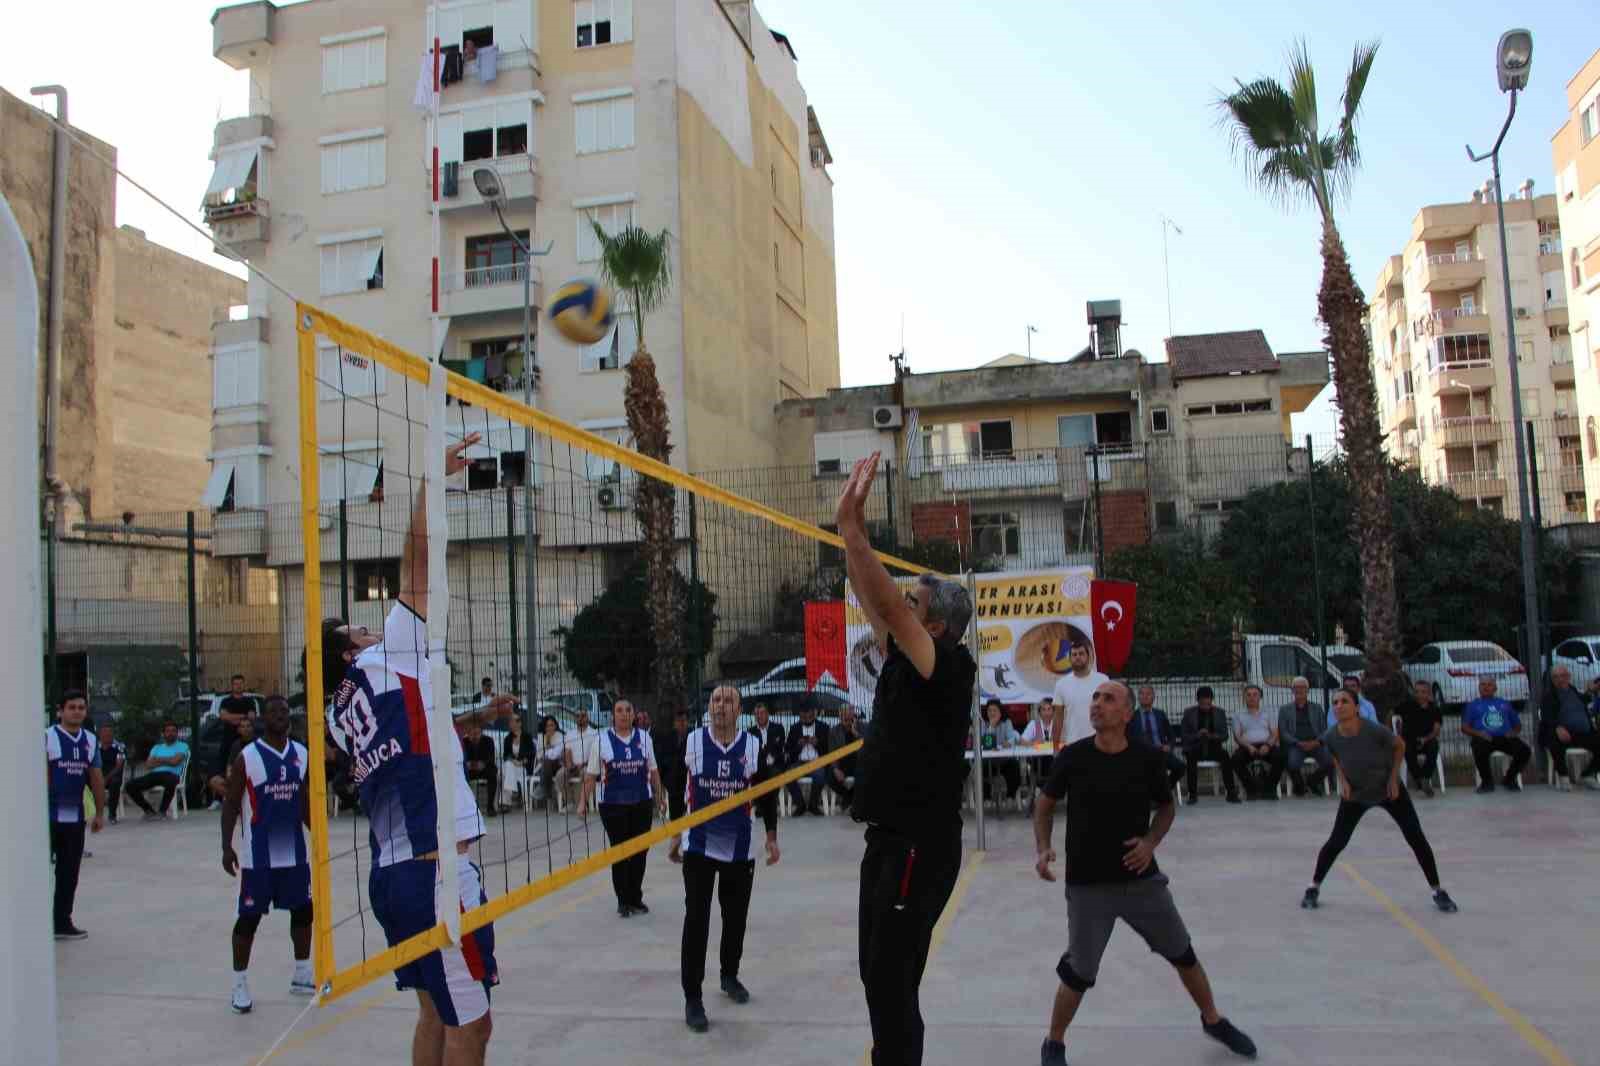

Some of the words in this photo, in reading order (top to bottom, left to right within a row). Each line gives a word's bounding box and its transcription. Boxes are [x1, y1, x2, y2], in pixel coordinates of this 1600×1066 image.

[980, 586, 998, 599] ER
[1007, 583, 1056, 598] ARASI
[977, 601, 1063, 617] URNUVASI
[717, 759, 731, 777] 15
